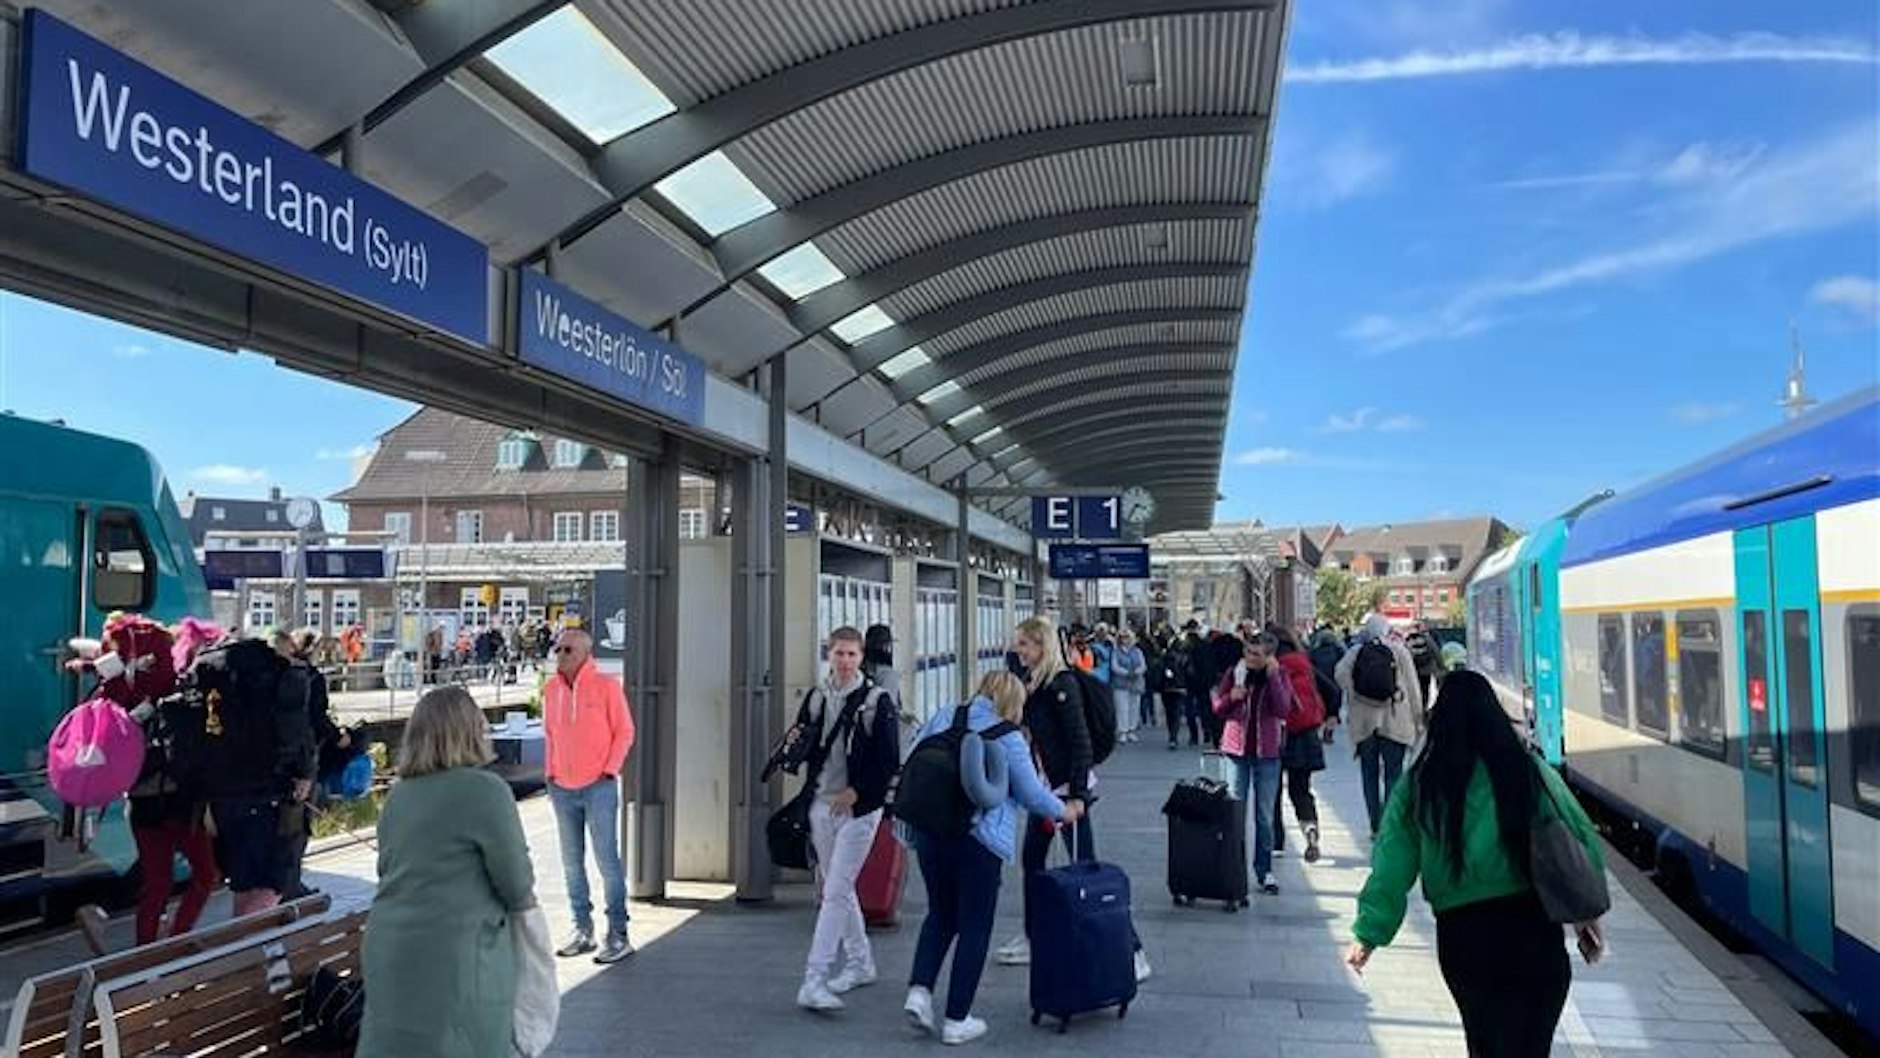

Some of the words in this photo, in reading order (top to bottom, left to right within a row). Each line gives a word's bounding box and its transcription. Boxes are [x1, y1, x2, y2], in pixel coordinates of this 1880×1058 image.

[68, 57, 355, 256] Westerland
[363, 218, 428, 290] (Sylt)
[536, 289, 647, 380] Weesterlön
[1047, 497, 1070, 529] E
[1102, 497, 1118, 529] 1
